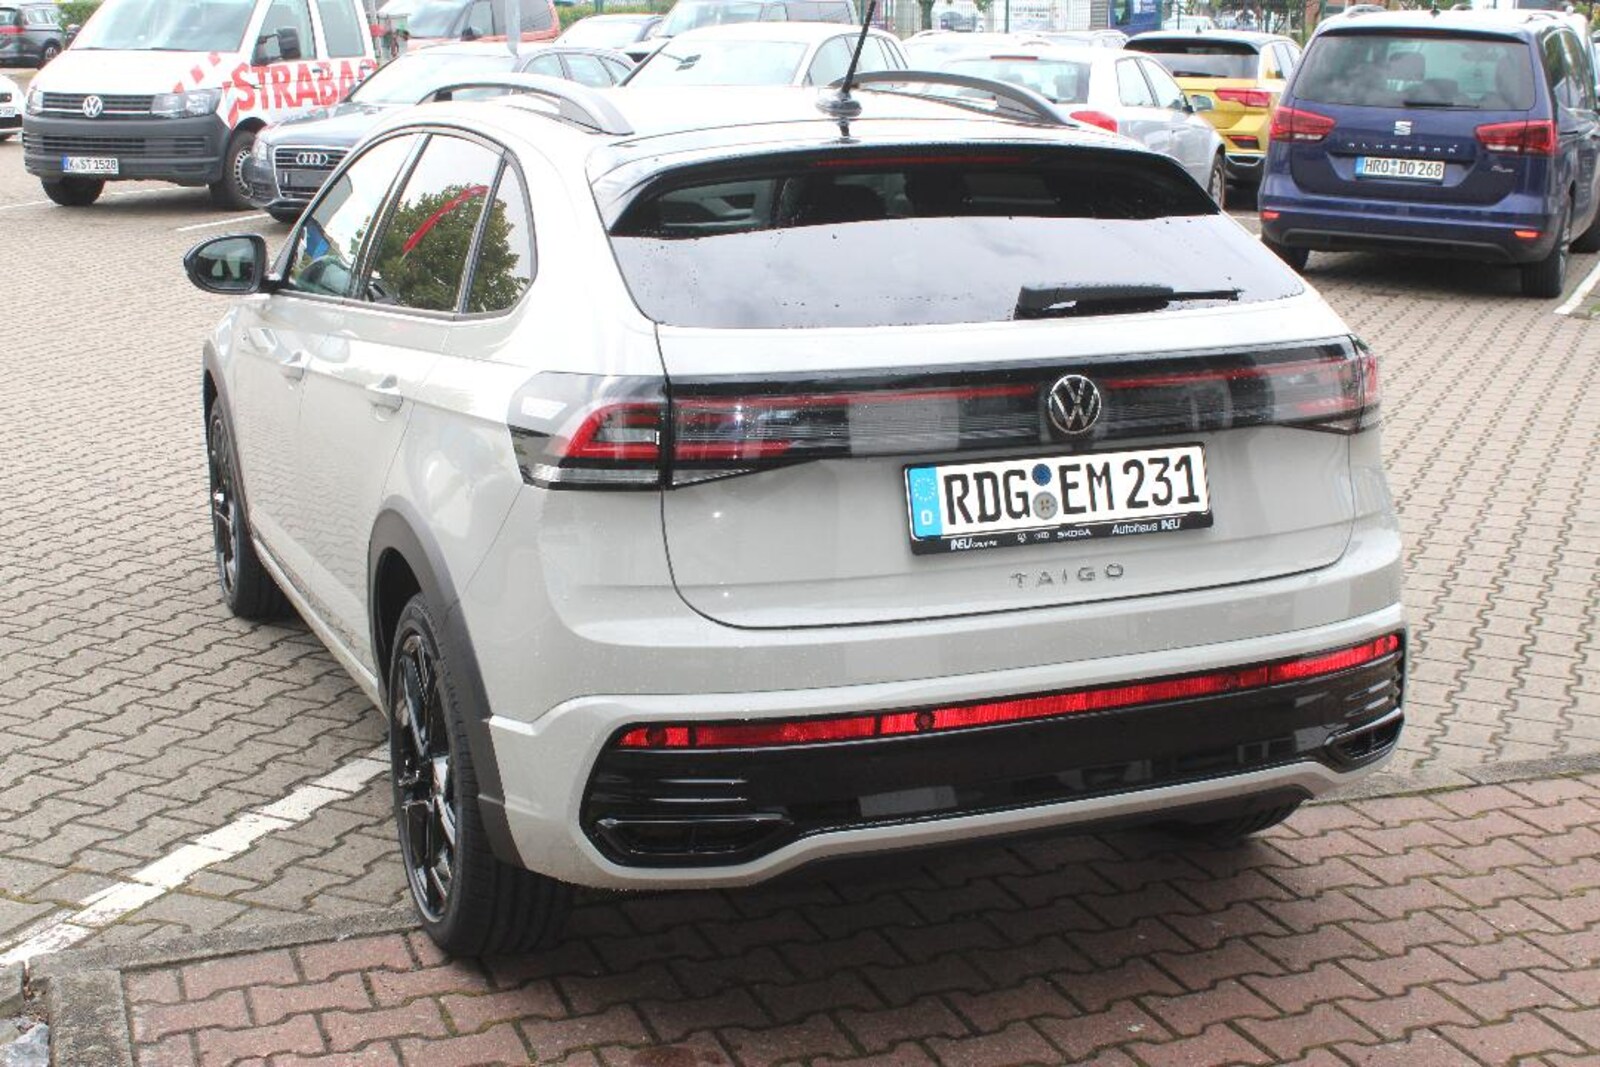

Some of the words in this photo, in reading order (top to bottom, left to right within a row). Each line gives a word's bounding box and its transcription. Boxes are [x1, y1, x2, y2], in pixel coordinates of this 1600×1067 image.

[94, 159, 117, 170] 1528
[1364, 159, 1389, 173] HRO
[1398, 161, 1416, 175] DO
[1417, 162, 1443, 178] 268
[943, 468, 1030, 525] RDG
[1058, 461, 1115, 515] EM
[1122, 455, 1200, 508] 231
[920, 509, 933, 526] D
[1111, 523, 1158, 536] Autohaus
[1009, 562, 1124, 589] TAIGO
